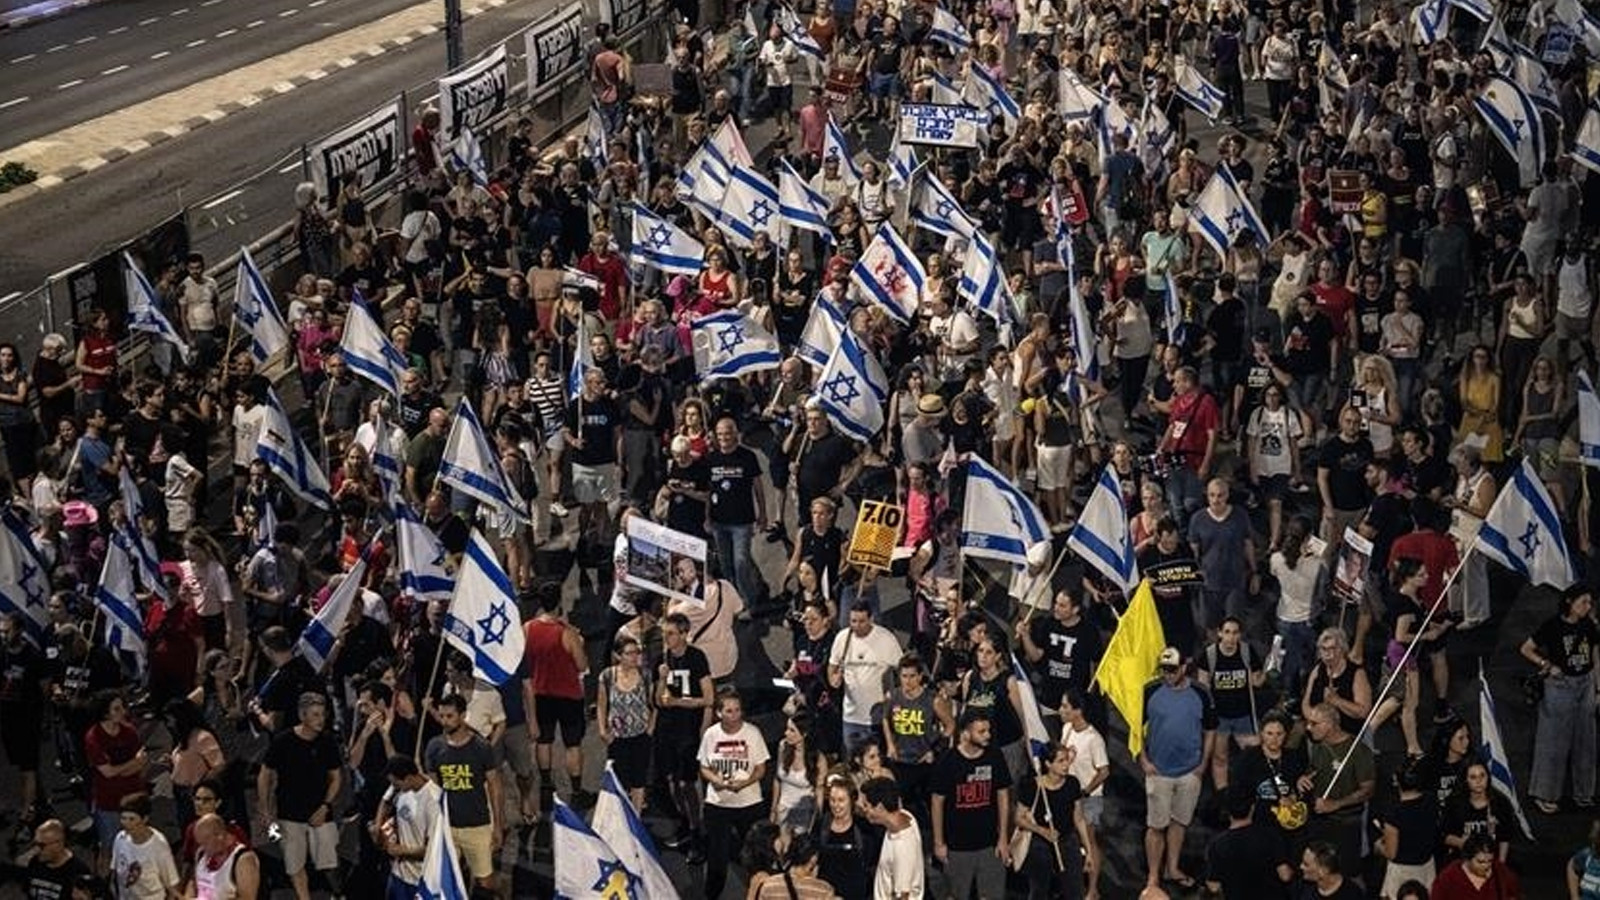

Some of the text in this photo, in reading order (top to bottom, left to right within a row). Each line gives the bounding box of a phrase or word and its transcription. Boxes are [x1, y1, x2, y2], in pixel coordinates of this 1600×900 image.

[863, 503, 901, 528] 7.10
[1049, 633, 1077, 657] די
[892, 707, 925, 723] SEAL
[440, 764, 474, 777] SEAL
